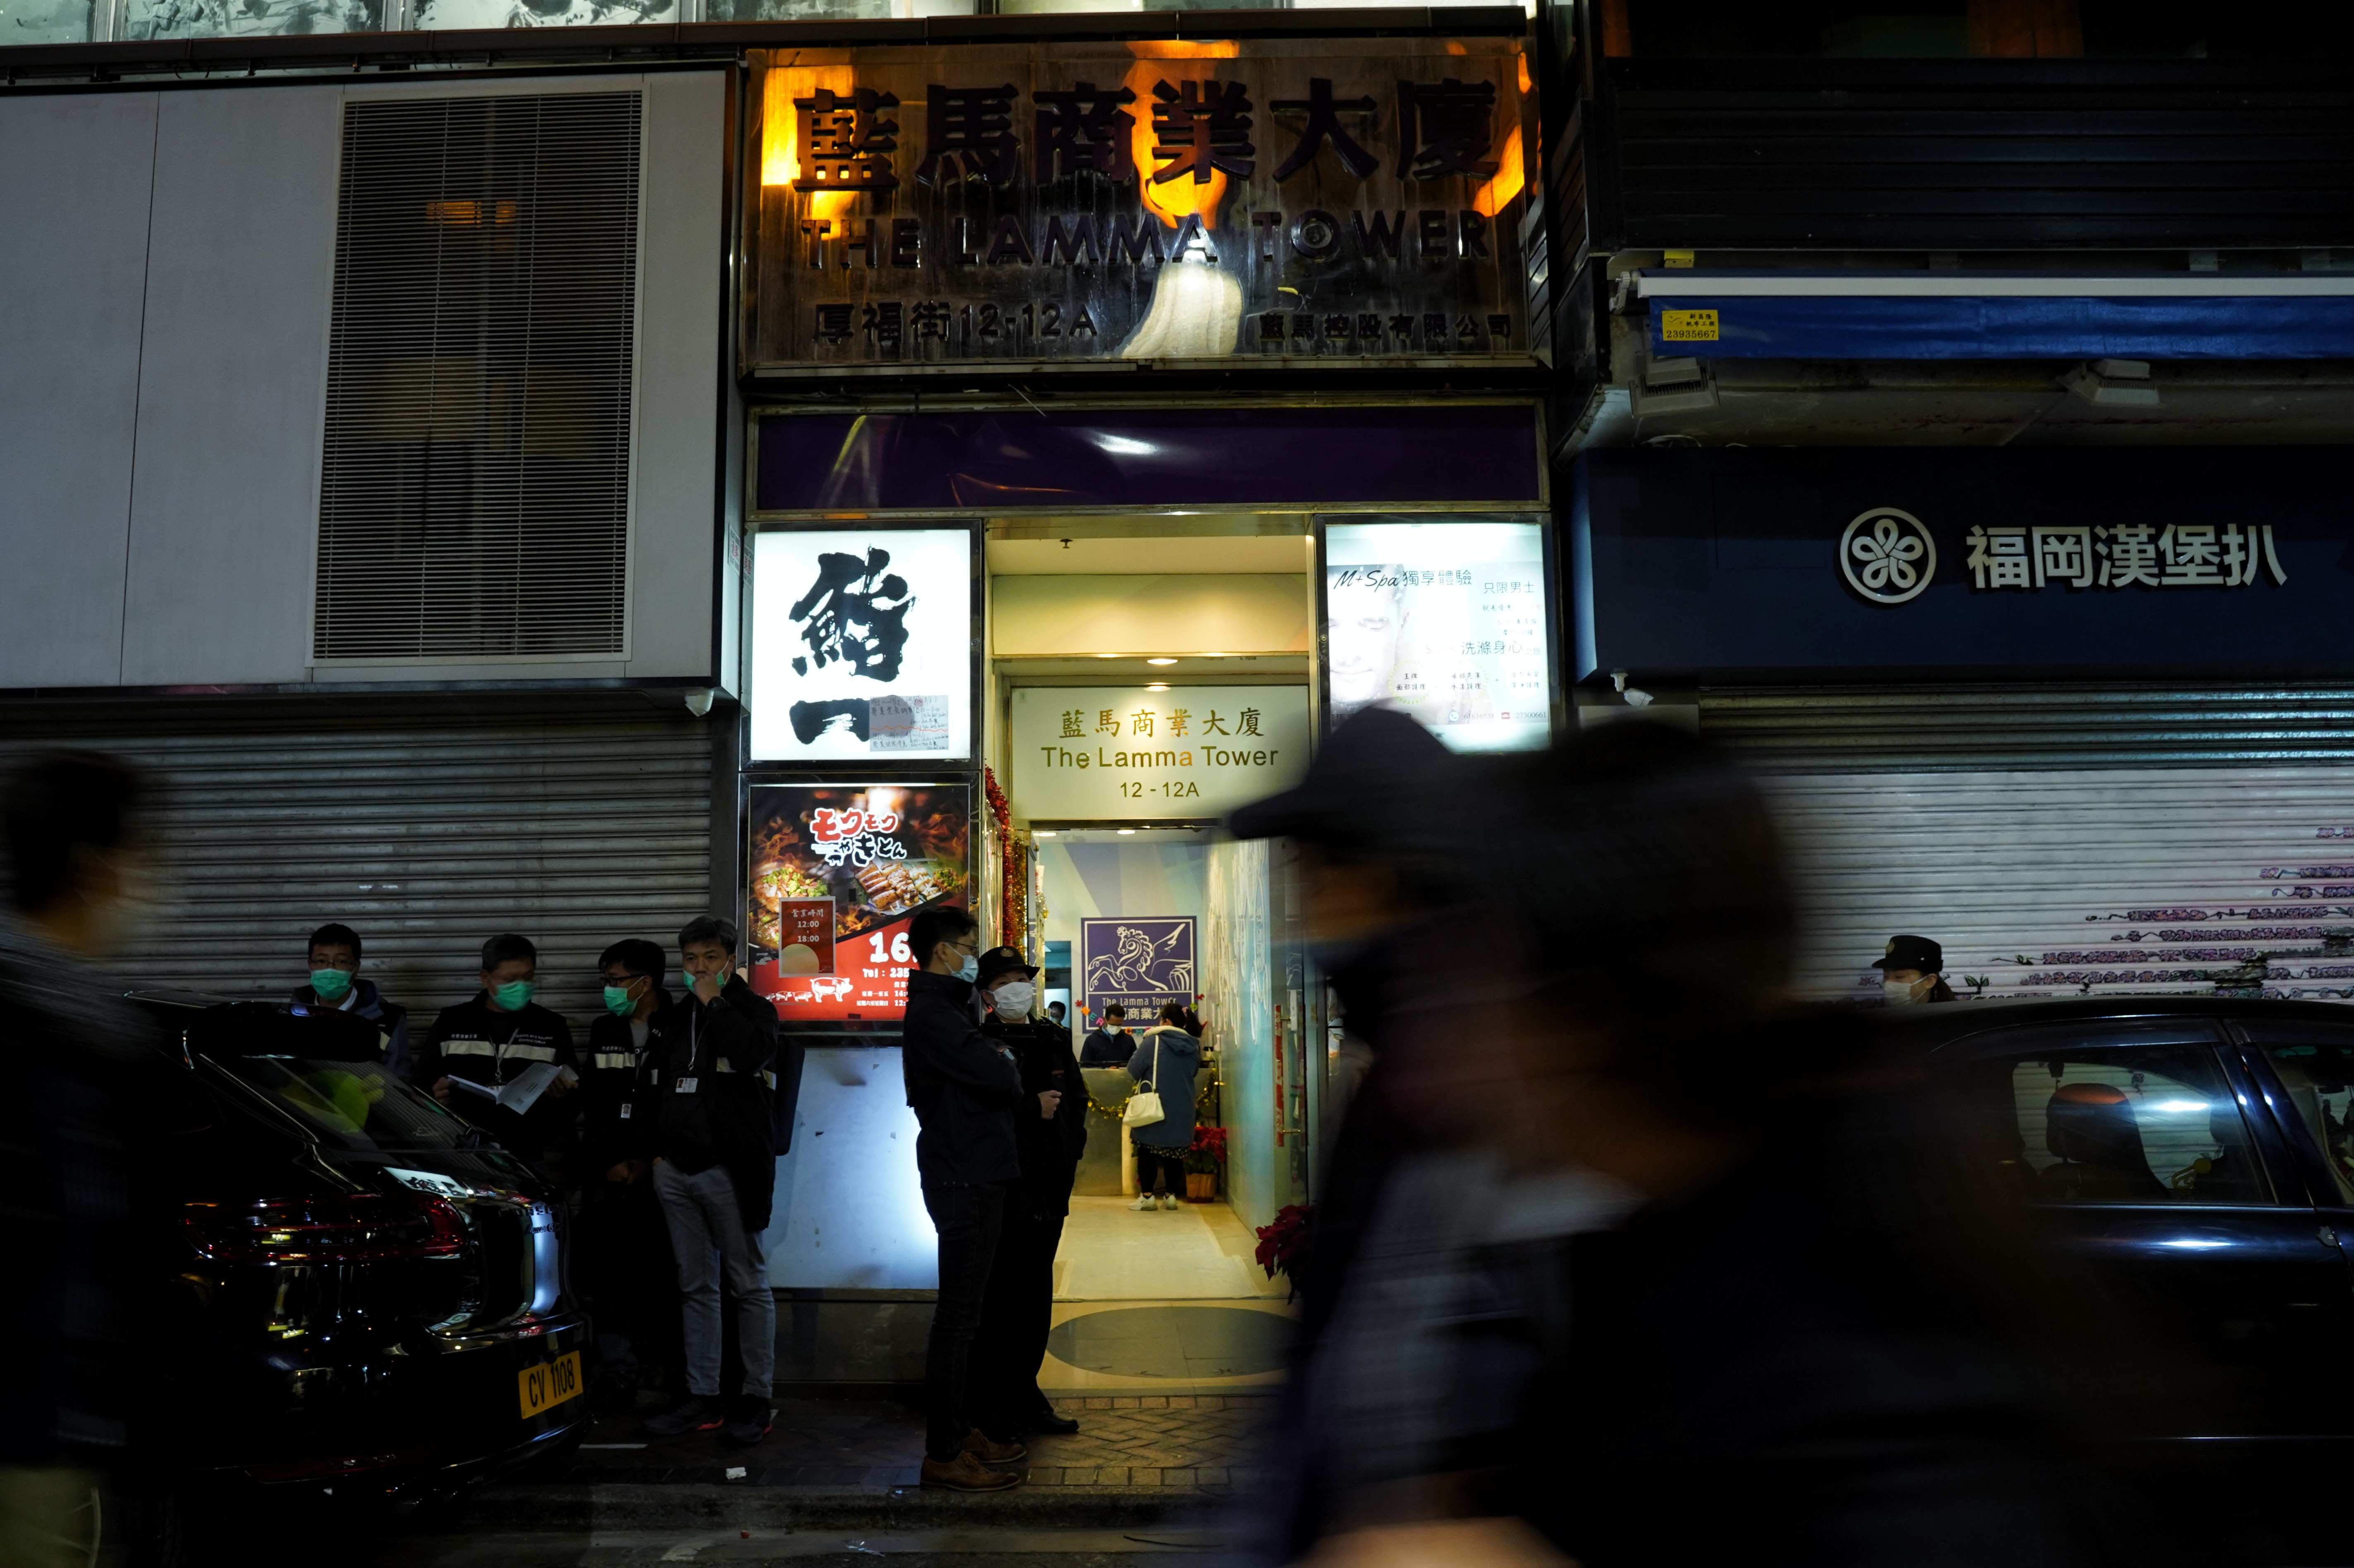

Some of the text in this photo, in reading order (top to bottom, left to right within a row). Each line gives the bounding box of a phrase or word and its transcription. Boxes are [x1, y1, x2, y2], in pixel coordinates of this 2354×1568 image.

[793, 79, 1499, 191] 藍馬商業大廈
[801, 209, 1490, 269] THE LAMMA TOWER
[1260, 313, 1512, 341] 藍馬控股有限公司
[1666, 330, 1716, 338] 23935667
[1965, 523, 2288, 589] 福岡漢堡扒
[1402, 569, 1472, 587] 獨享體驗
[1484, 581, 1535, 594] 只限男士
[1059, 707, 1264, 738] 藍馬商業大廈
[1041, 745, 1279, 769] The Lamma Tower
[811, 809, 897, 843] モクモク
[838, 833, 906, 866] やきとん
[869, 931, 918, 963] 16
[890, 967, 911, 978] 235
[1102, 996, 1177, 1006] The Lamma Tower
[529, 1358, 575, 1408] CV 1108
